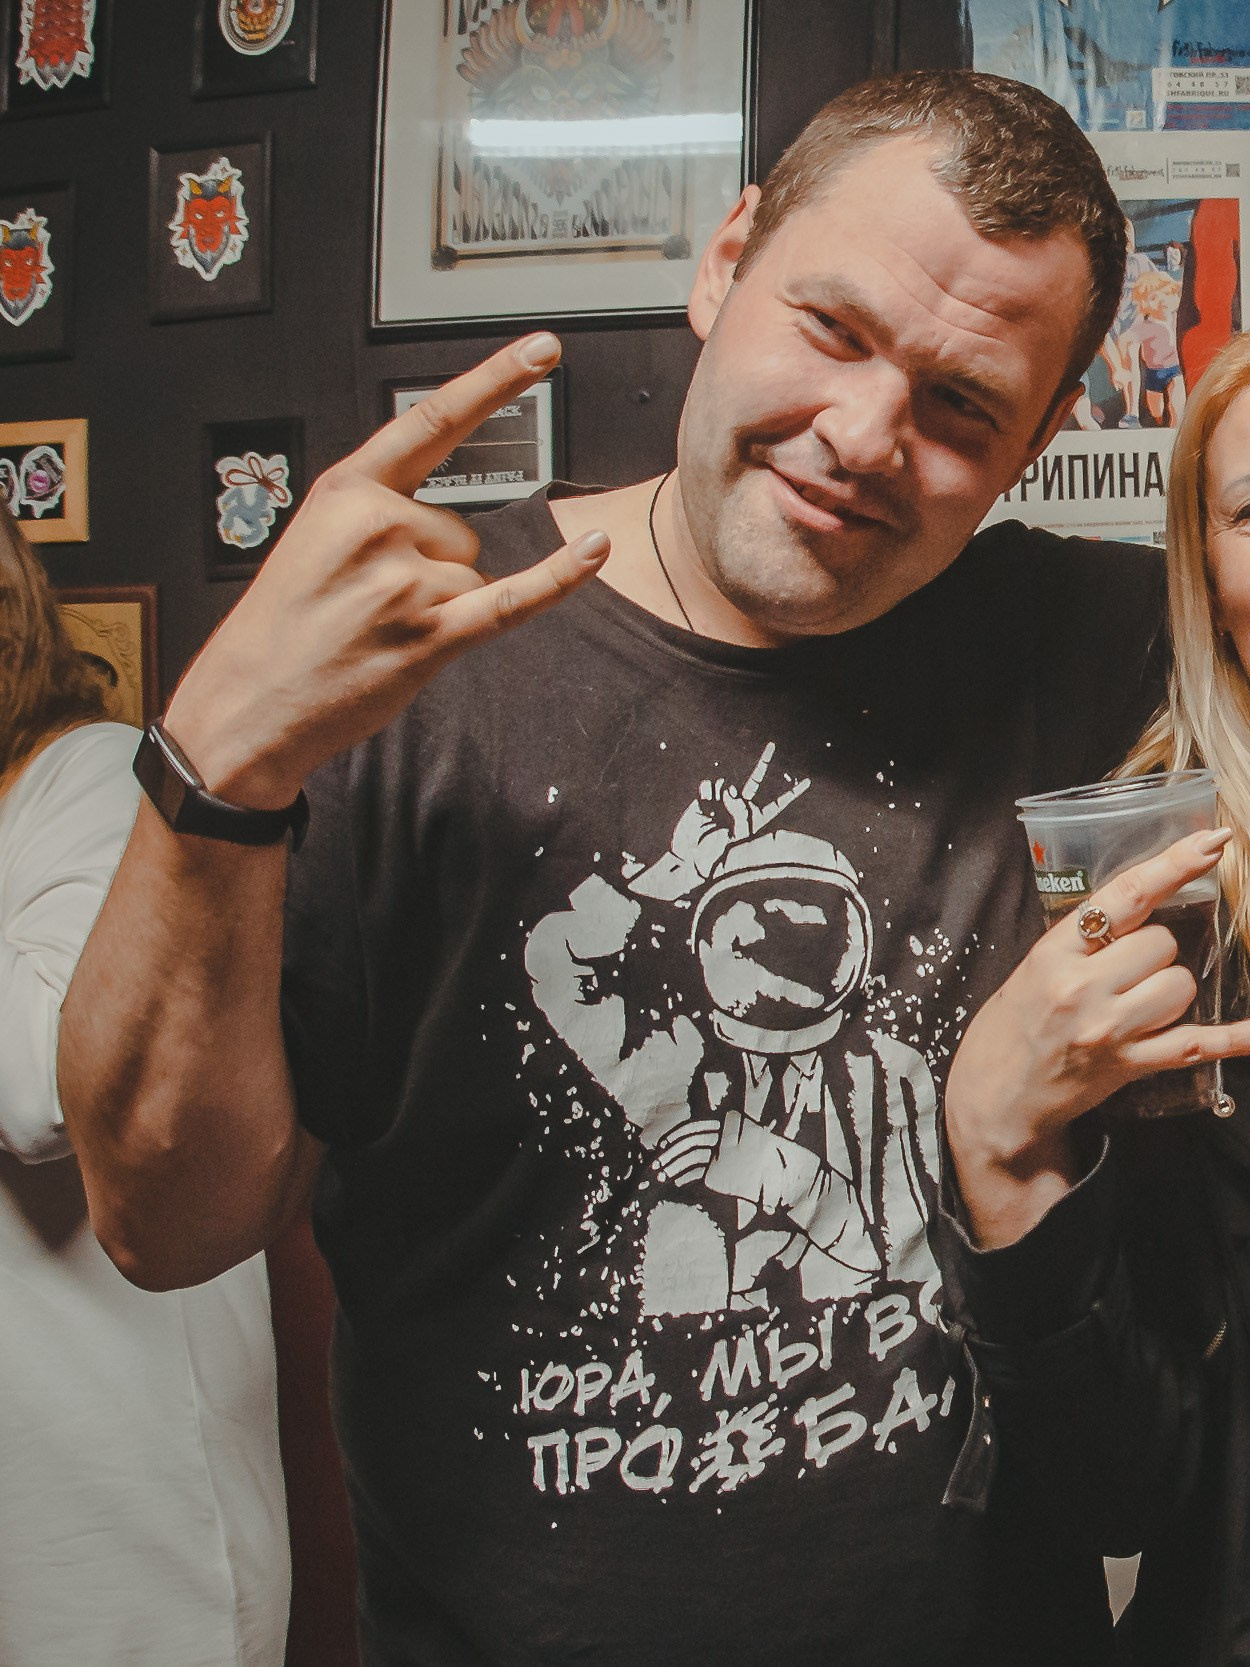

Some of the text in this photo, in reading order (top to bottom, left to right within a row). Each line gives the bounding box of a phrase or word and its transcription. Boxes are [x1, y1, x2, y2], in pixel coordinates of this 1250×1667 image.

[1004, 451, 1167, 503] РИПИНА
[520, 1348, 673, 1418] ЮРА,
[700, 1303, 834, 1401] МЫ
